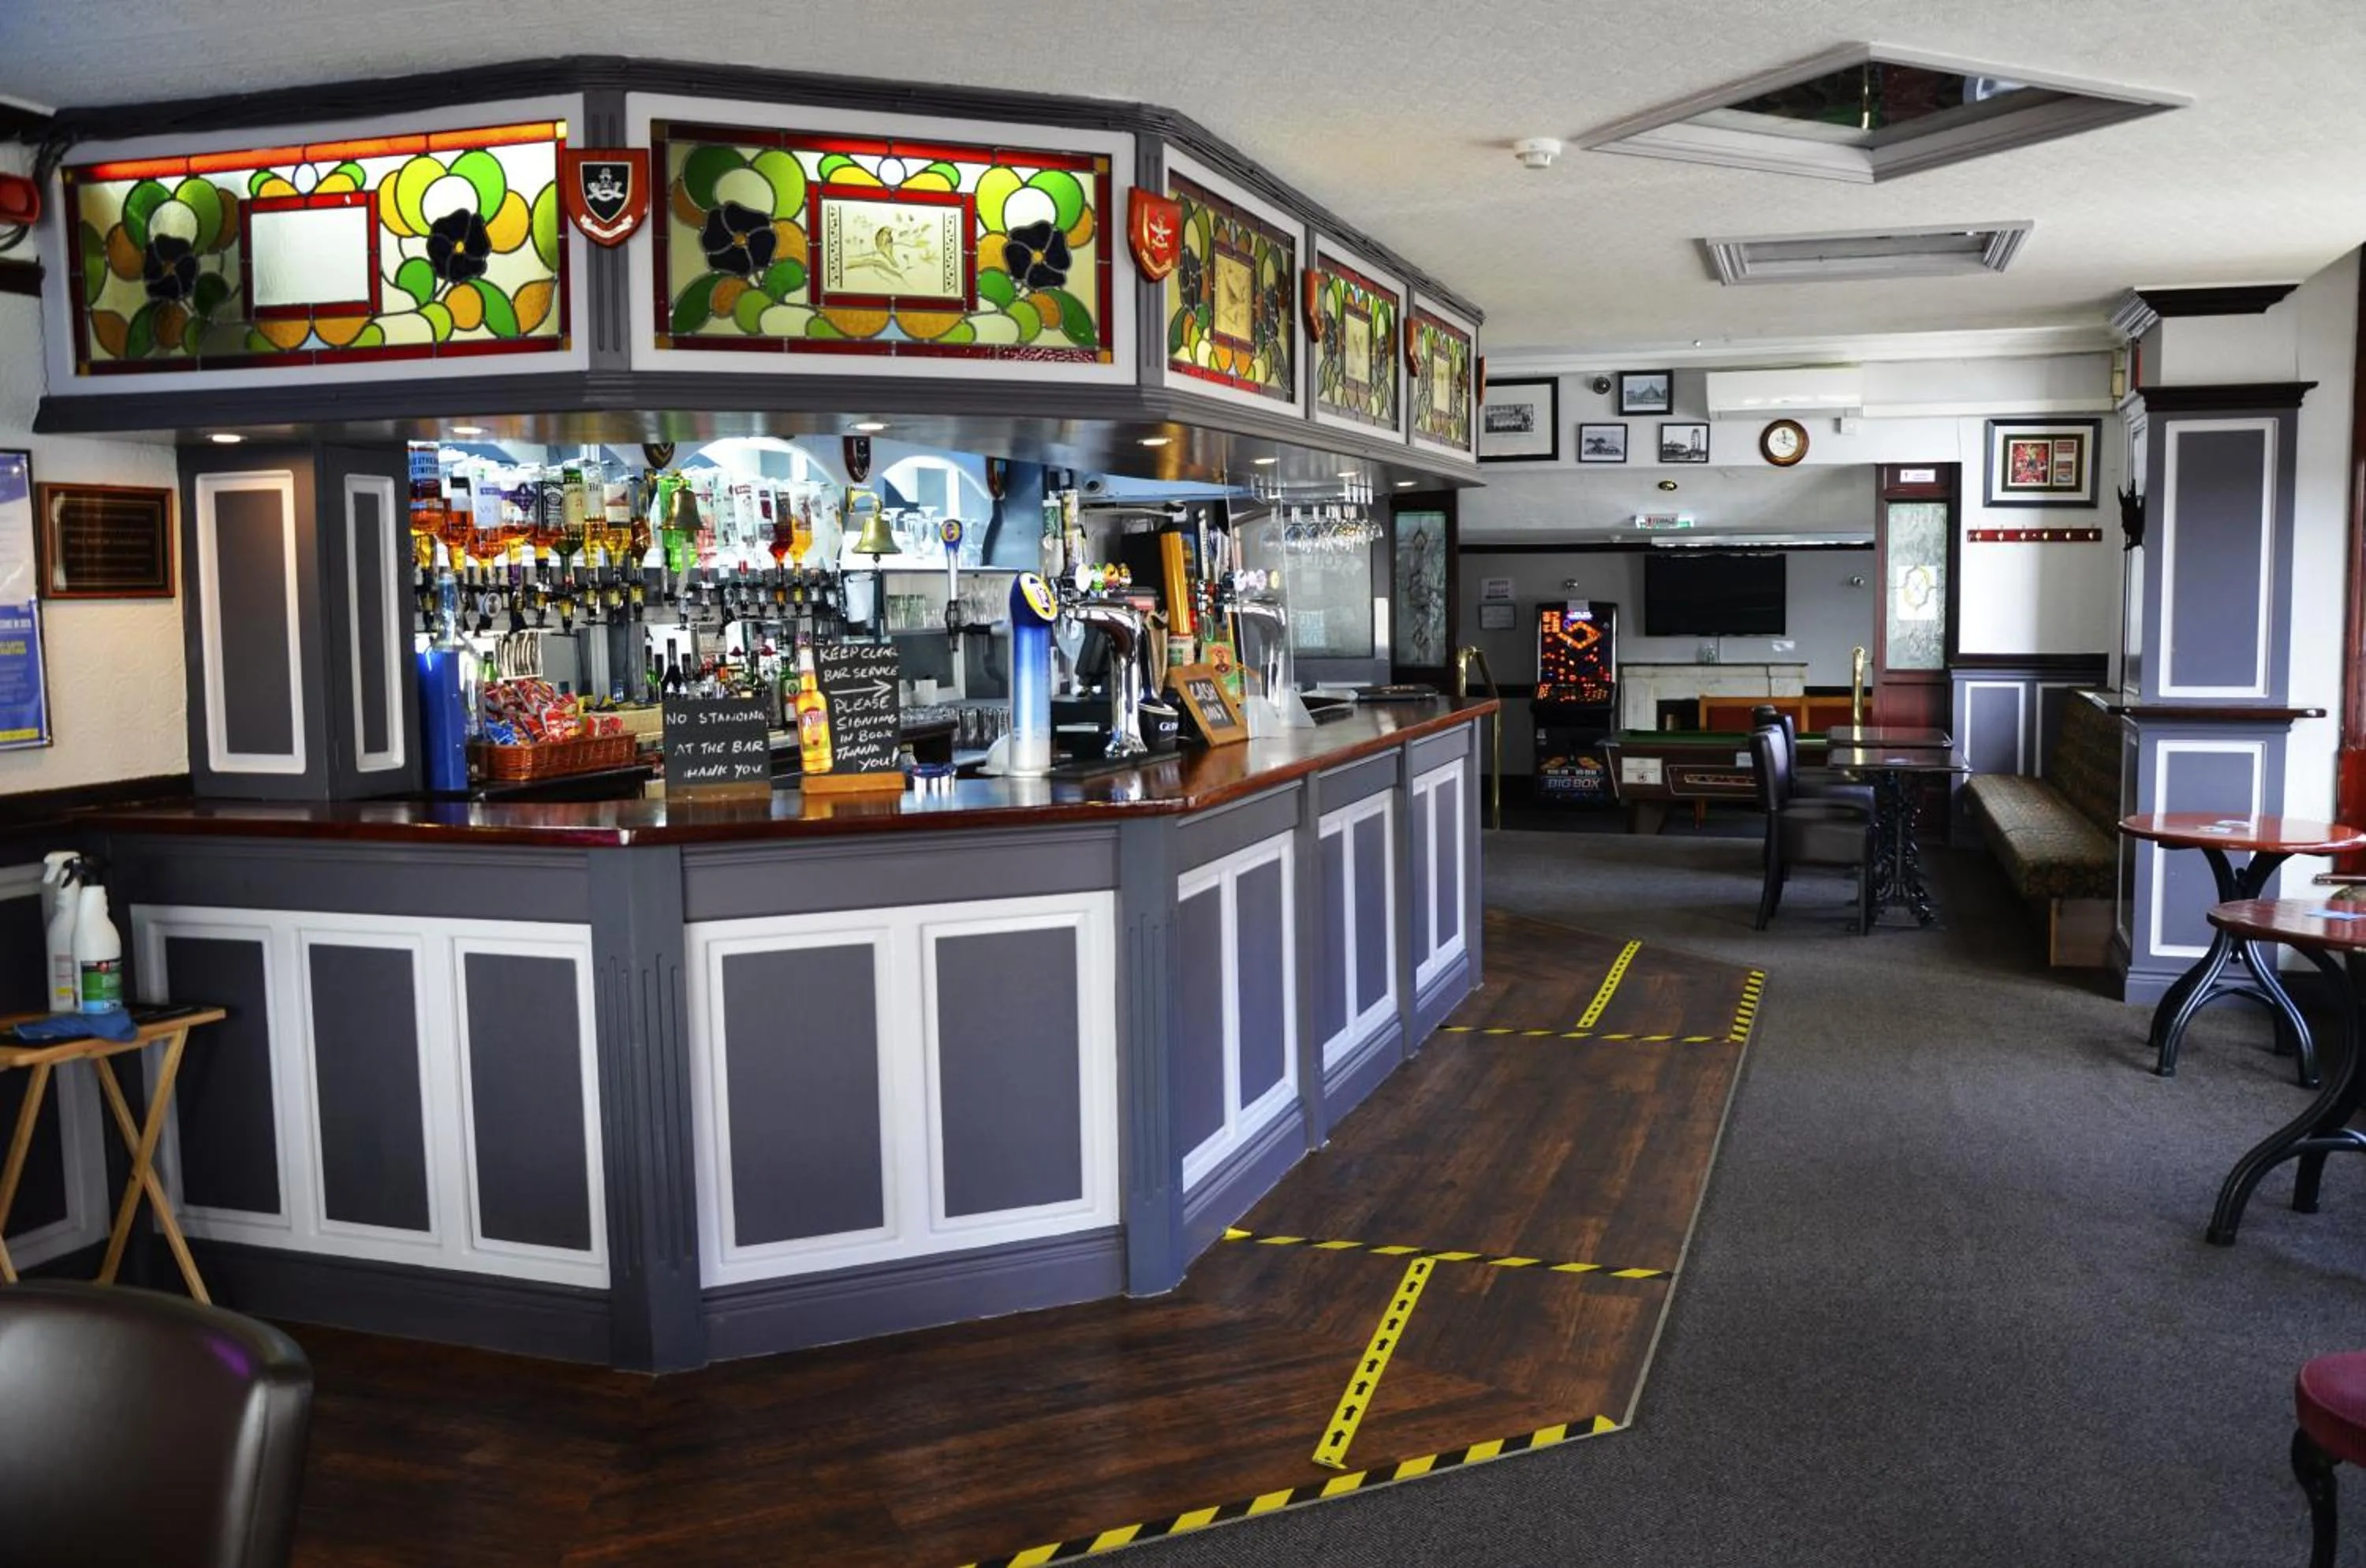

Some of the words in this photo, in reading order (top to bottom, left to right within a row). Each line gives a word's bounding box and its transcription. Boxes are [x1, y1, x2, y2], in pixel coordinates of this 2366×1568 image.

[819, 646, 859, 663] KEEP
[860, 647, 899, 659] CLEAR
[823, 667, 851, 683] BAR
[853, 665, 899, 679] SERVICE
[834, 695, 890, 714] PLEASE
[666, 712, 687, 725] NO
[698, 710, 765, 724] STANDING
[836, 714, 897, 731] SIGNING
[840, 734, 854, 743] IN
[859, 730, 893, 743] BOOK
[674, 742, 694, 756] AT
[700, 742, 726, 755] THE
[732, 740, 764, 753] BAR
[836, 744, 880, 760] THANK
[858, 746, 900, 772] YOU!
[684, 764, 728, 778] HANK
[734, 764, 763, 779] YOU
[1548, 778, 1572, 788] BIG
[1573, 778, 1600, 788] BOX
